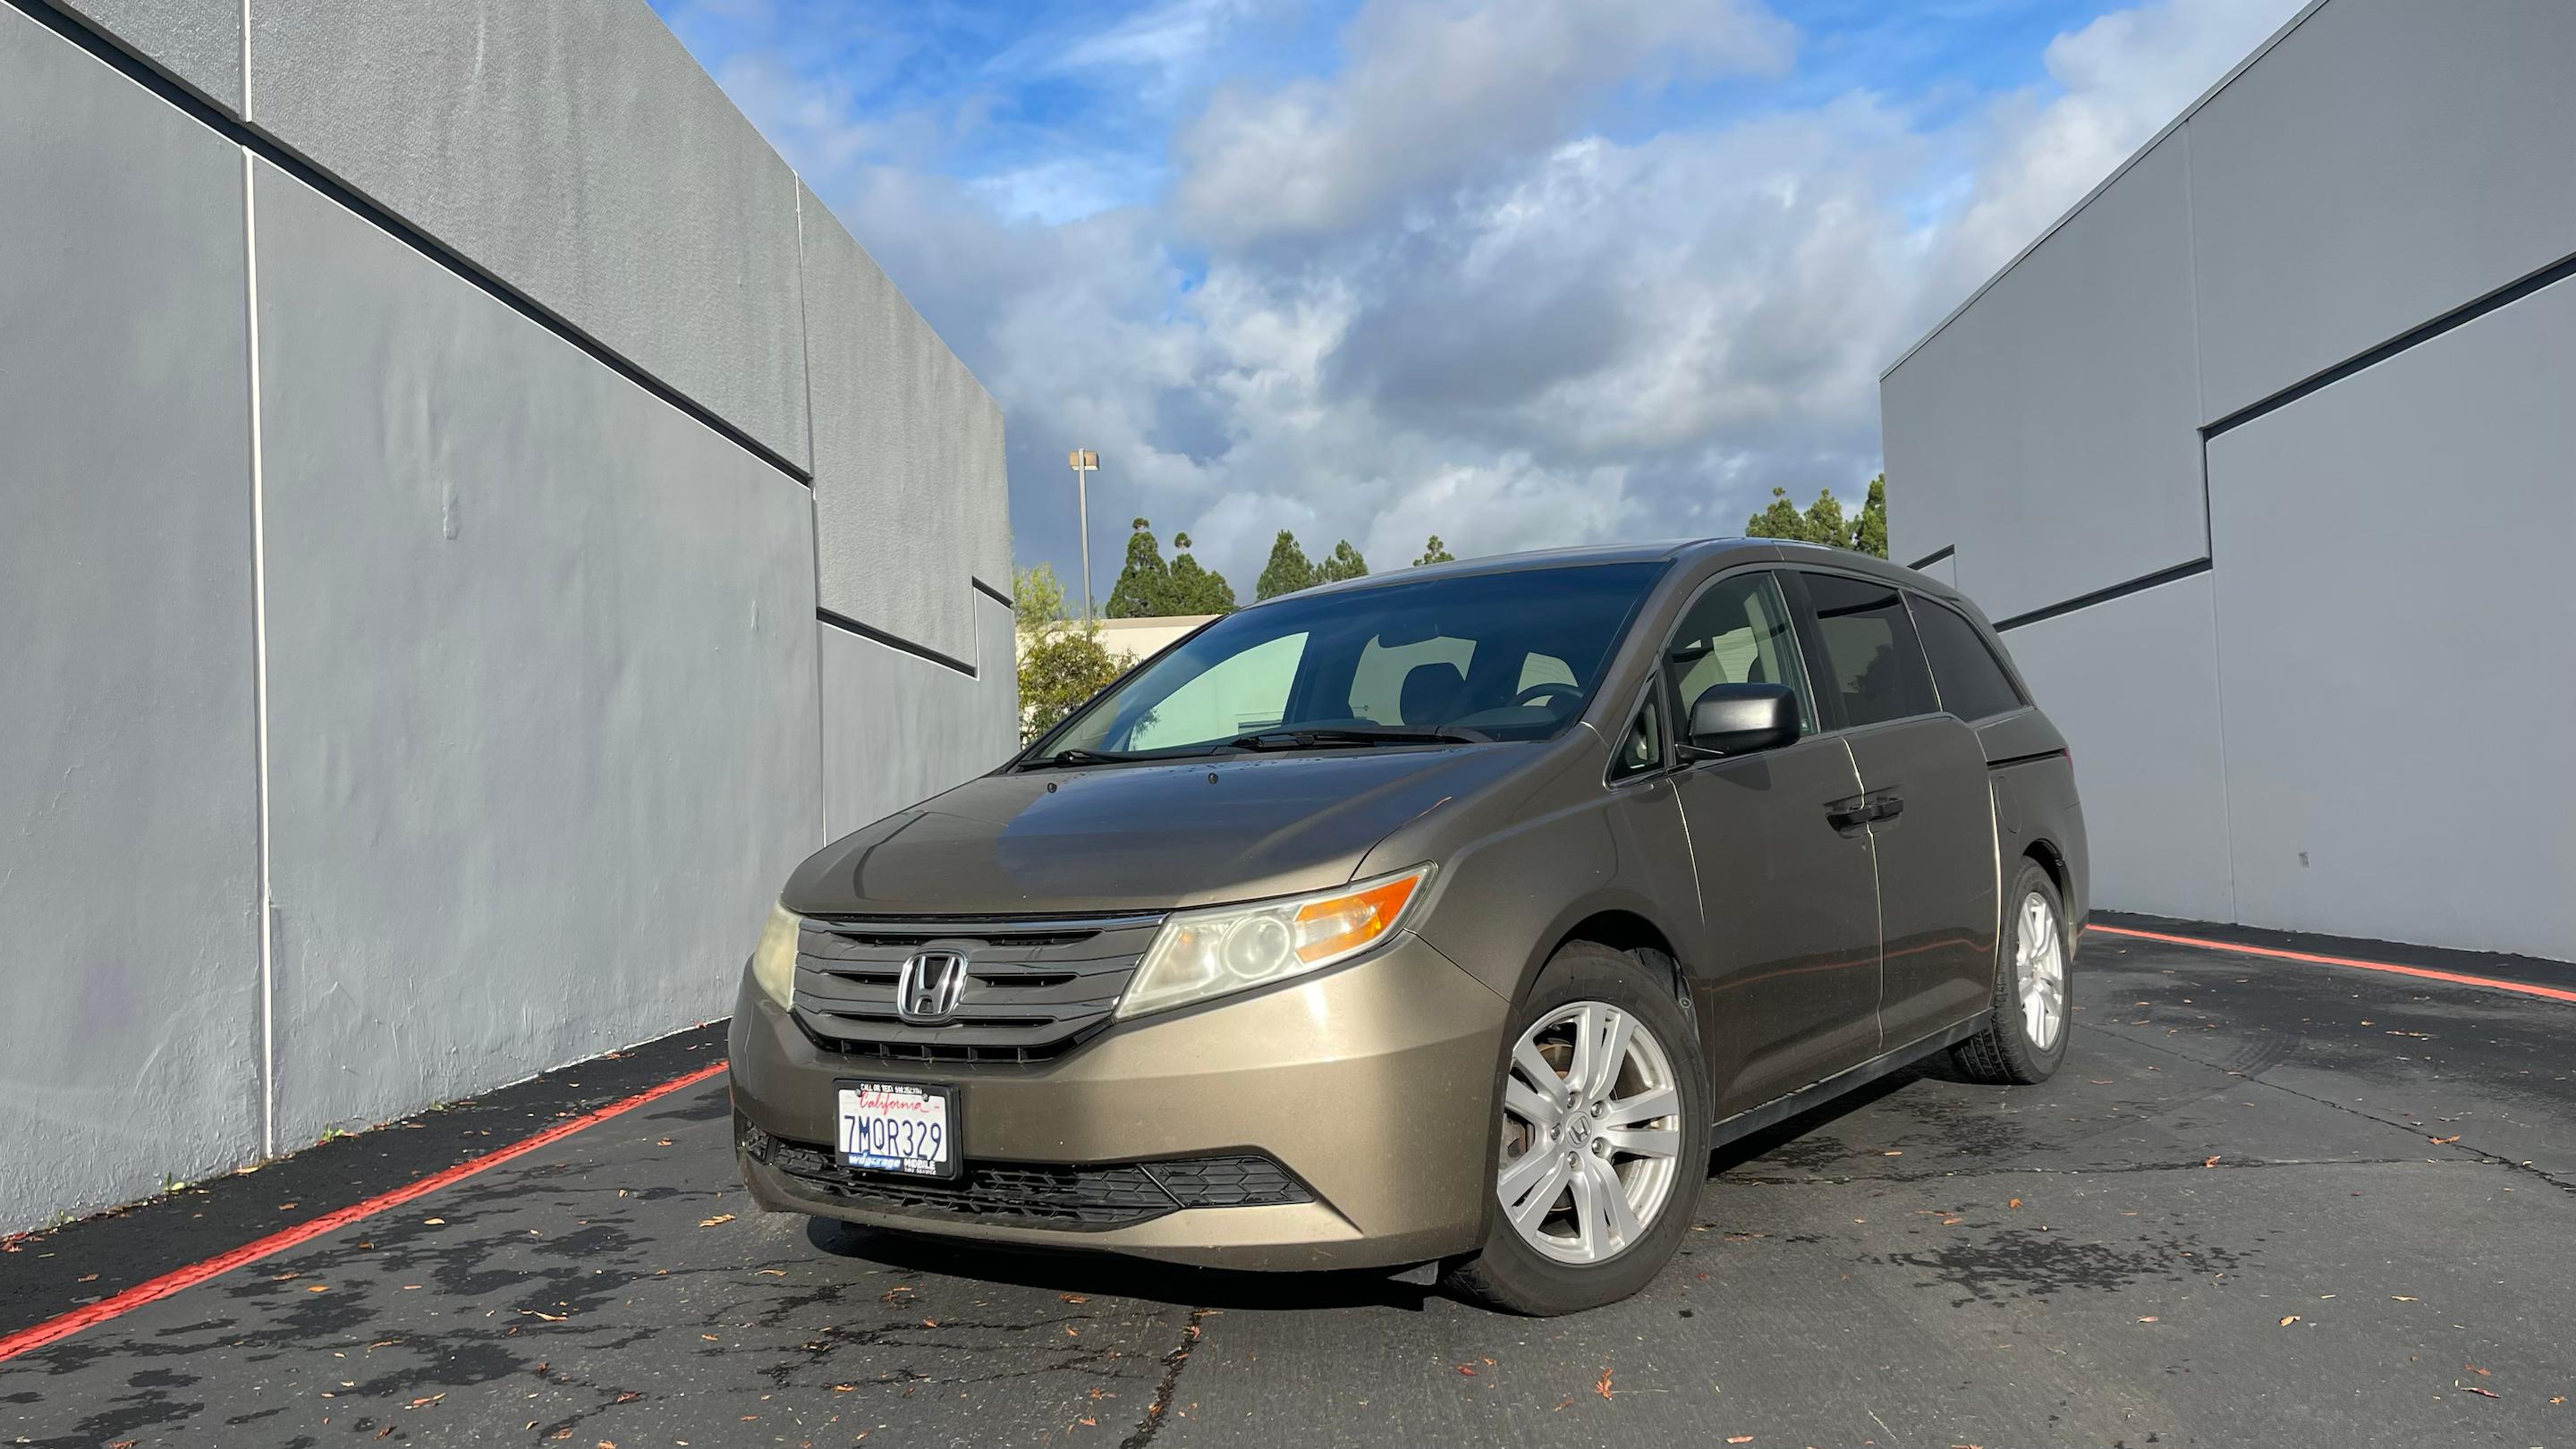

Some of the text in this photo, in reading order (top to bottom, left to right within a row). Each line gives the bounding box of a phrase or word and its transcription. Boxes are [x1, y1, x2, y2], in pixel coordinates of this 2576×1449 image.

[908, 953, 958, 1016] H
[860, 1090, 930, 1115] California
[903, 1158, 936, 1170] MOBILE
